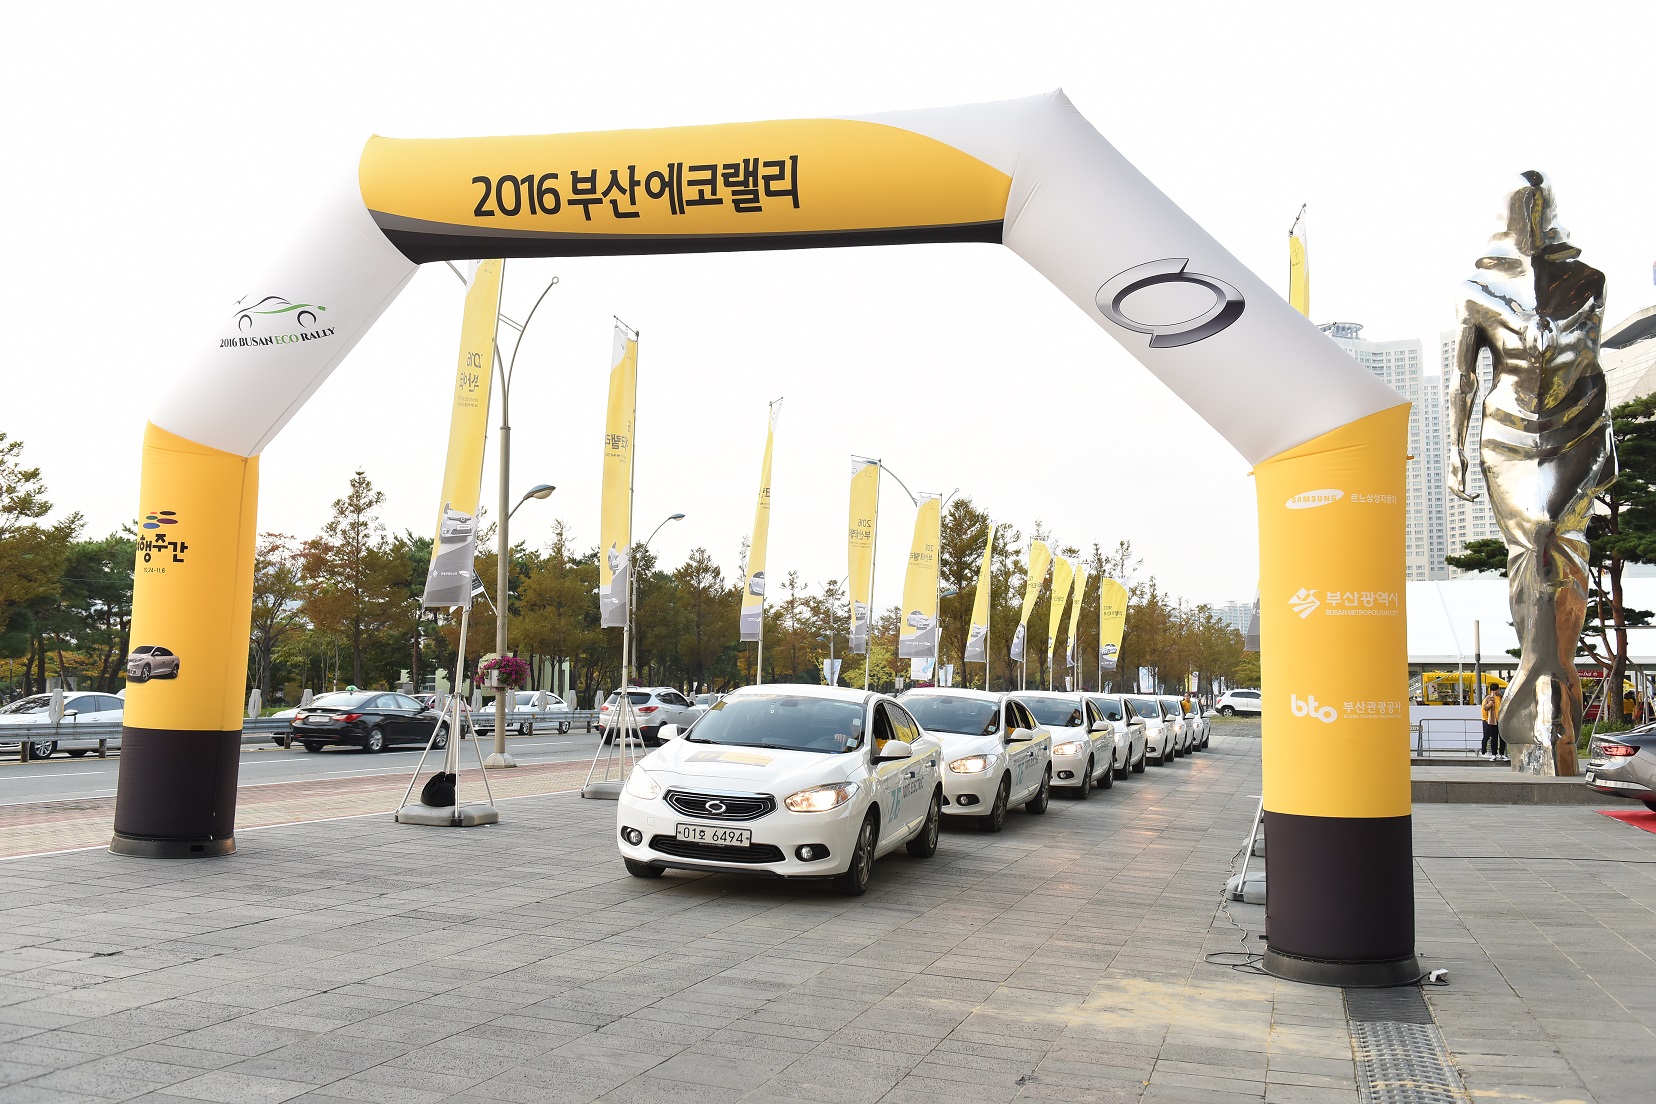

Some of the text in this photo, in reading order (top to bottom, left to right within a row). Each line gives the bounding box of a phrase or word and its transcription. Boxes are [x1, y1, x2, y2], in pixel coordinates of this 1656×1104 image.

[471, 155, 800, 221] 2016 부산 에코랠리
[219, 327, 336, 348] 2016 BUSAN ECO RALLY
[1291, 495, 1338, 504] SAMSUNG
[1325, 591, 1399, 608] 부산광역시
[1290, 693, 1338, 724] bto
[1343, 701, 1401, 714] 부산관광공사
[683, 826, 744, 844] 01호 6494
